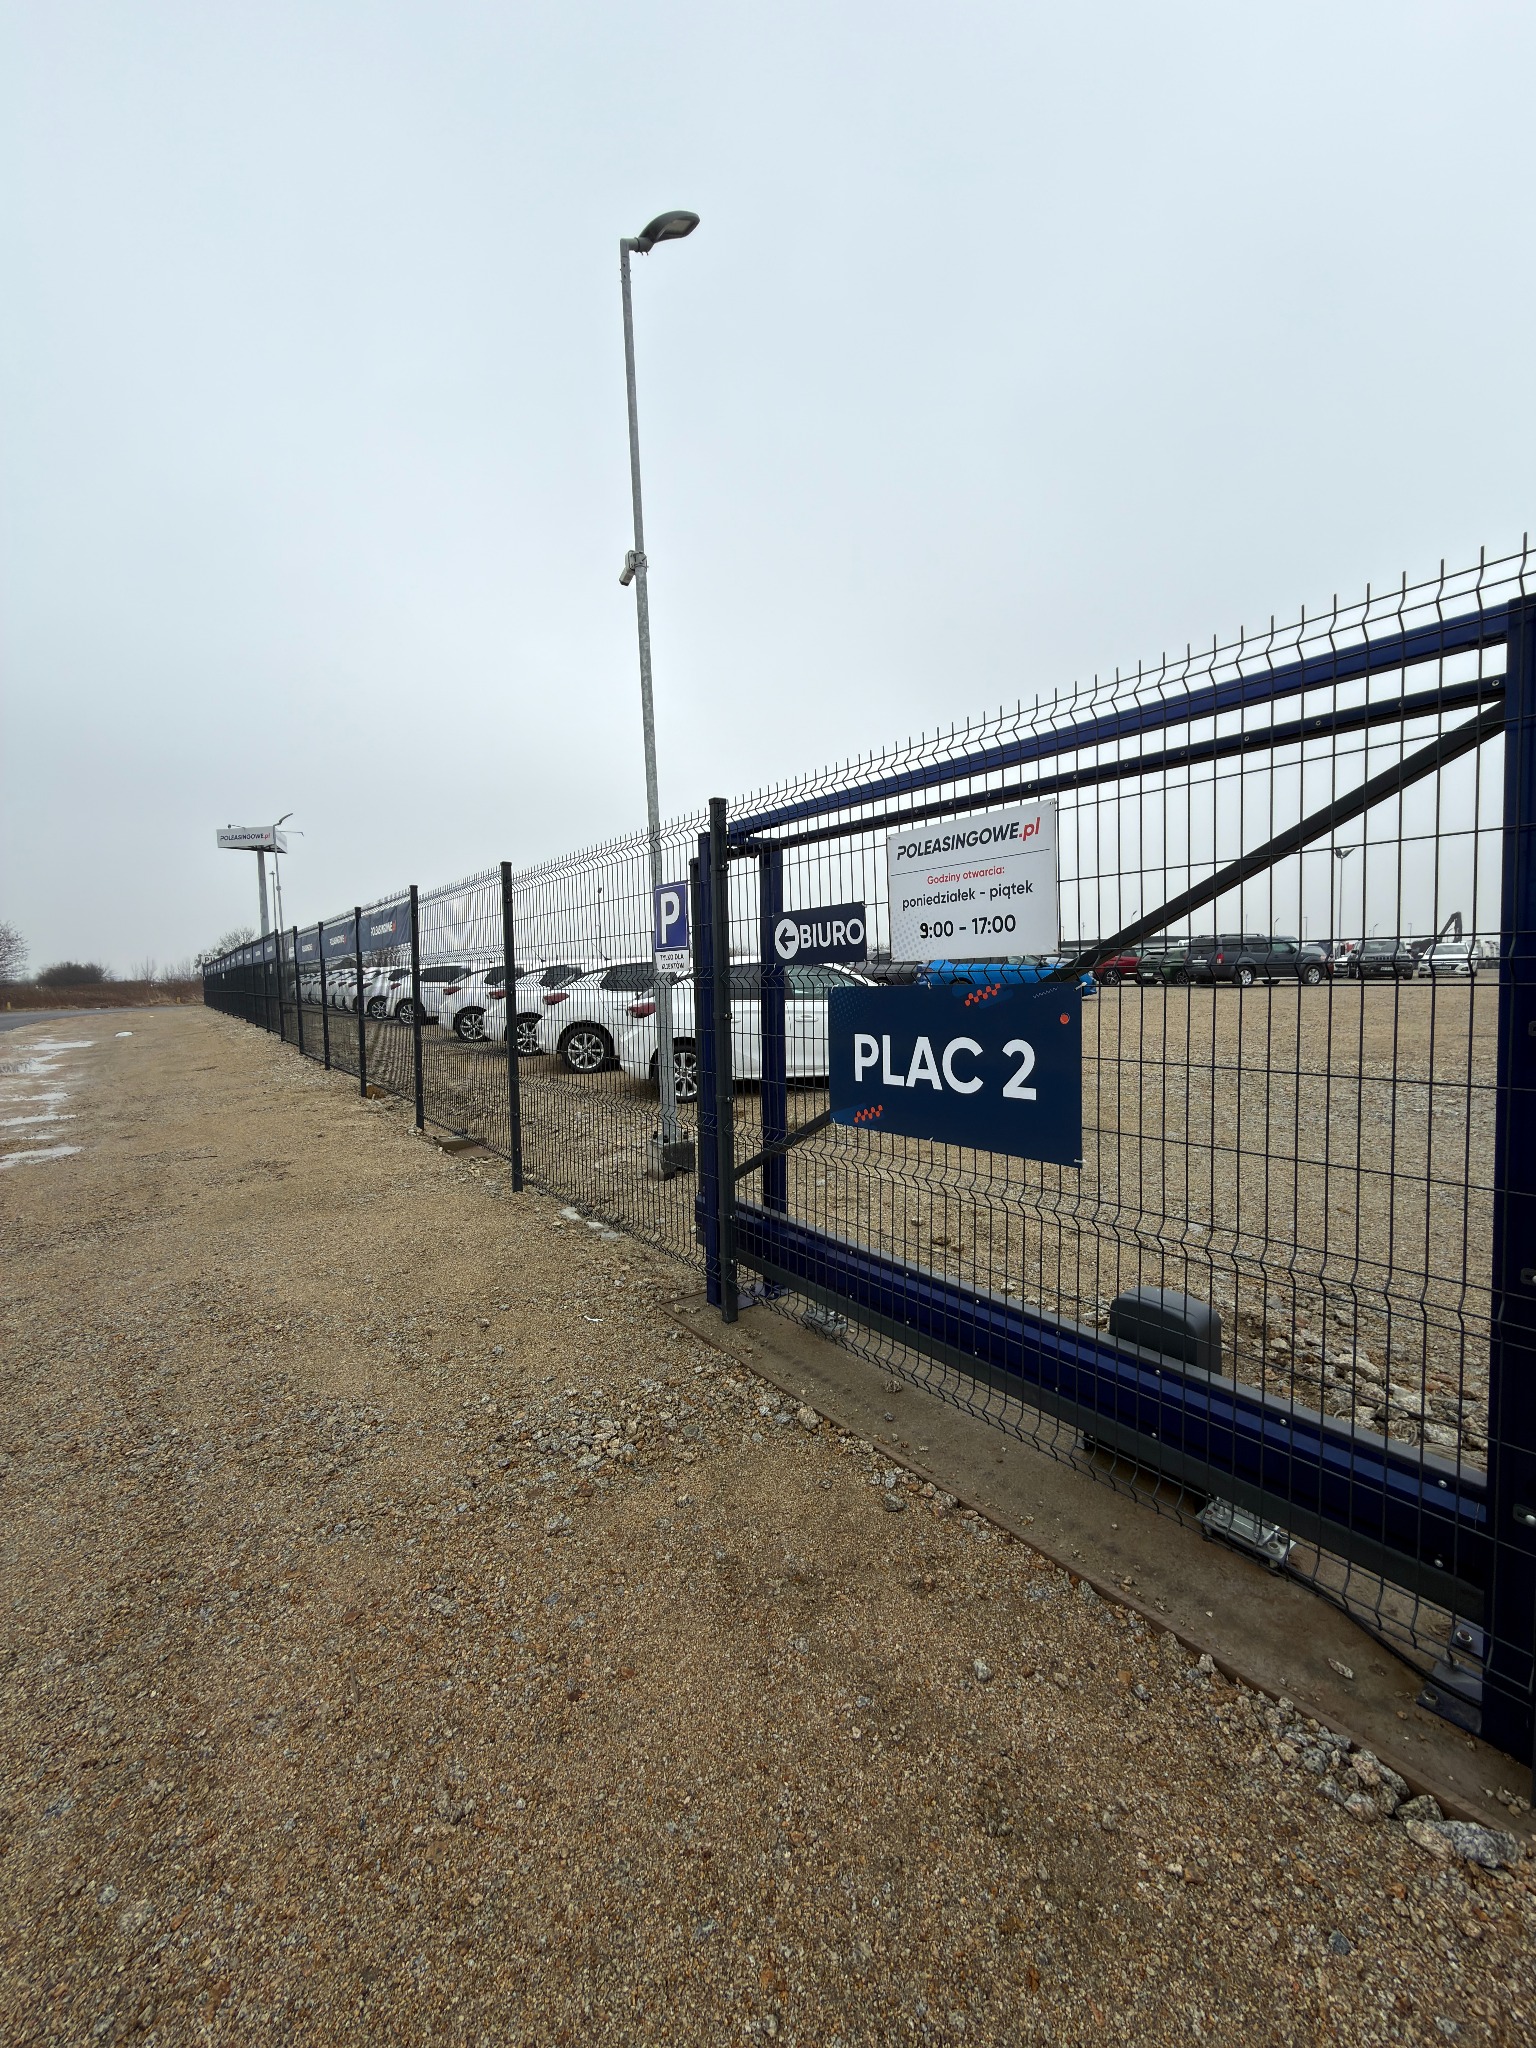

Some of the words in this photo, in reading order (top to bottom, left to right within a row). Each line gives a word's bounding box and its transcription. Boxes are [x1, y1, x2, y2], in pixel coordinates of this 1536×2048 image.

[896, 816, 1041, 861] POLEASINGOWE.pl
[927, 872, 961, 885] Godziny
[962, 865, 1006, 880] otwarcia:
[902, 887, 976, 912] poniedziałek
[989, 879, 1034, 902] piątek
[660, 891, 680, 945] P
[799, 918, 865, 949] BIURO
[919, 920, 954, 939] 9:00
[971, 914, 1017, 935] 17:00
[854, 1033, 984, 1094] PLAC
[1001, 1038, 1037, 1101] 2
